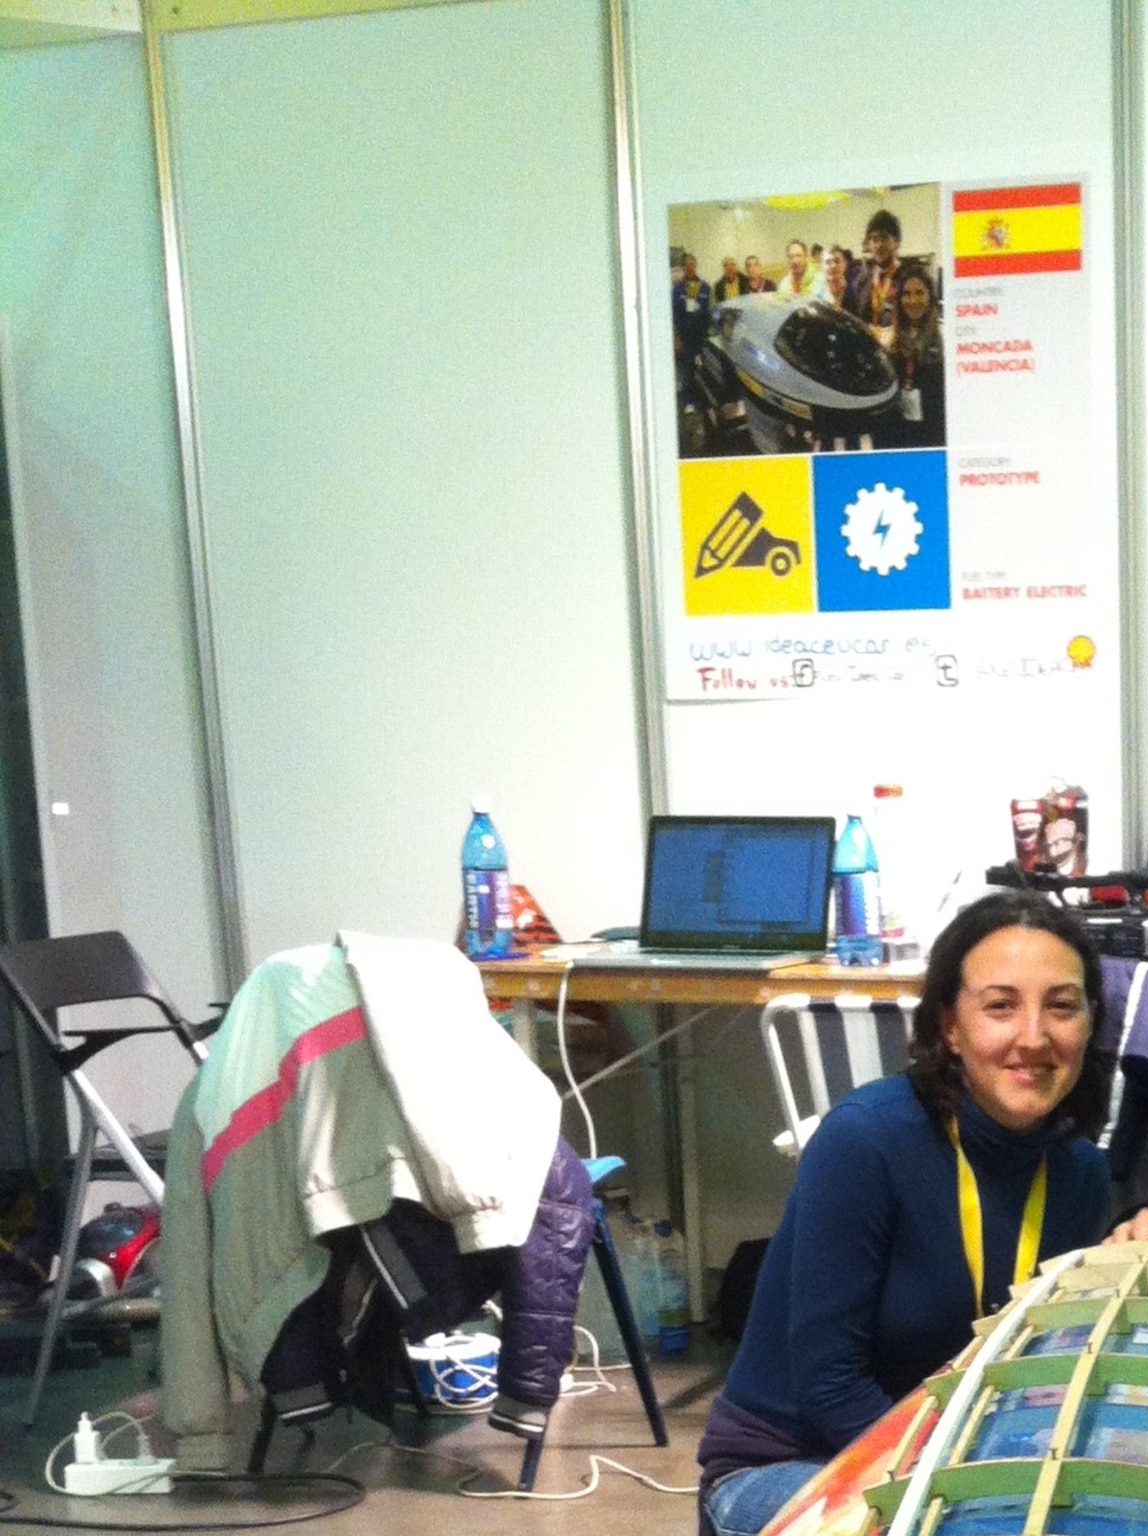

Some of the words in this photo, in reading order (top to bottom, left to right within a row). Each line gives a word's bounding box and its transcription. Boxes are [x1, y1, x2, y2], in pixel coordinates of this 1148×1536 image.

[956, 303, 999, 318] SPAIN
[956, 340, 1032, 354] MONCADA
[959, 471, 1040, 486] PROTOTYPE
[962, 586, 1019, 601] BATTERY
[1026, 584, 1087, 600] ELECTRIC
[697, 666, 757, 692] Follow
